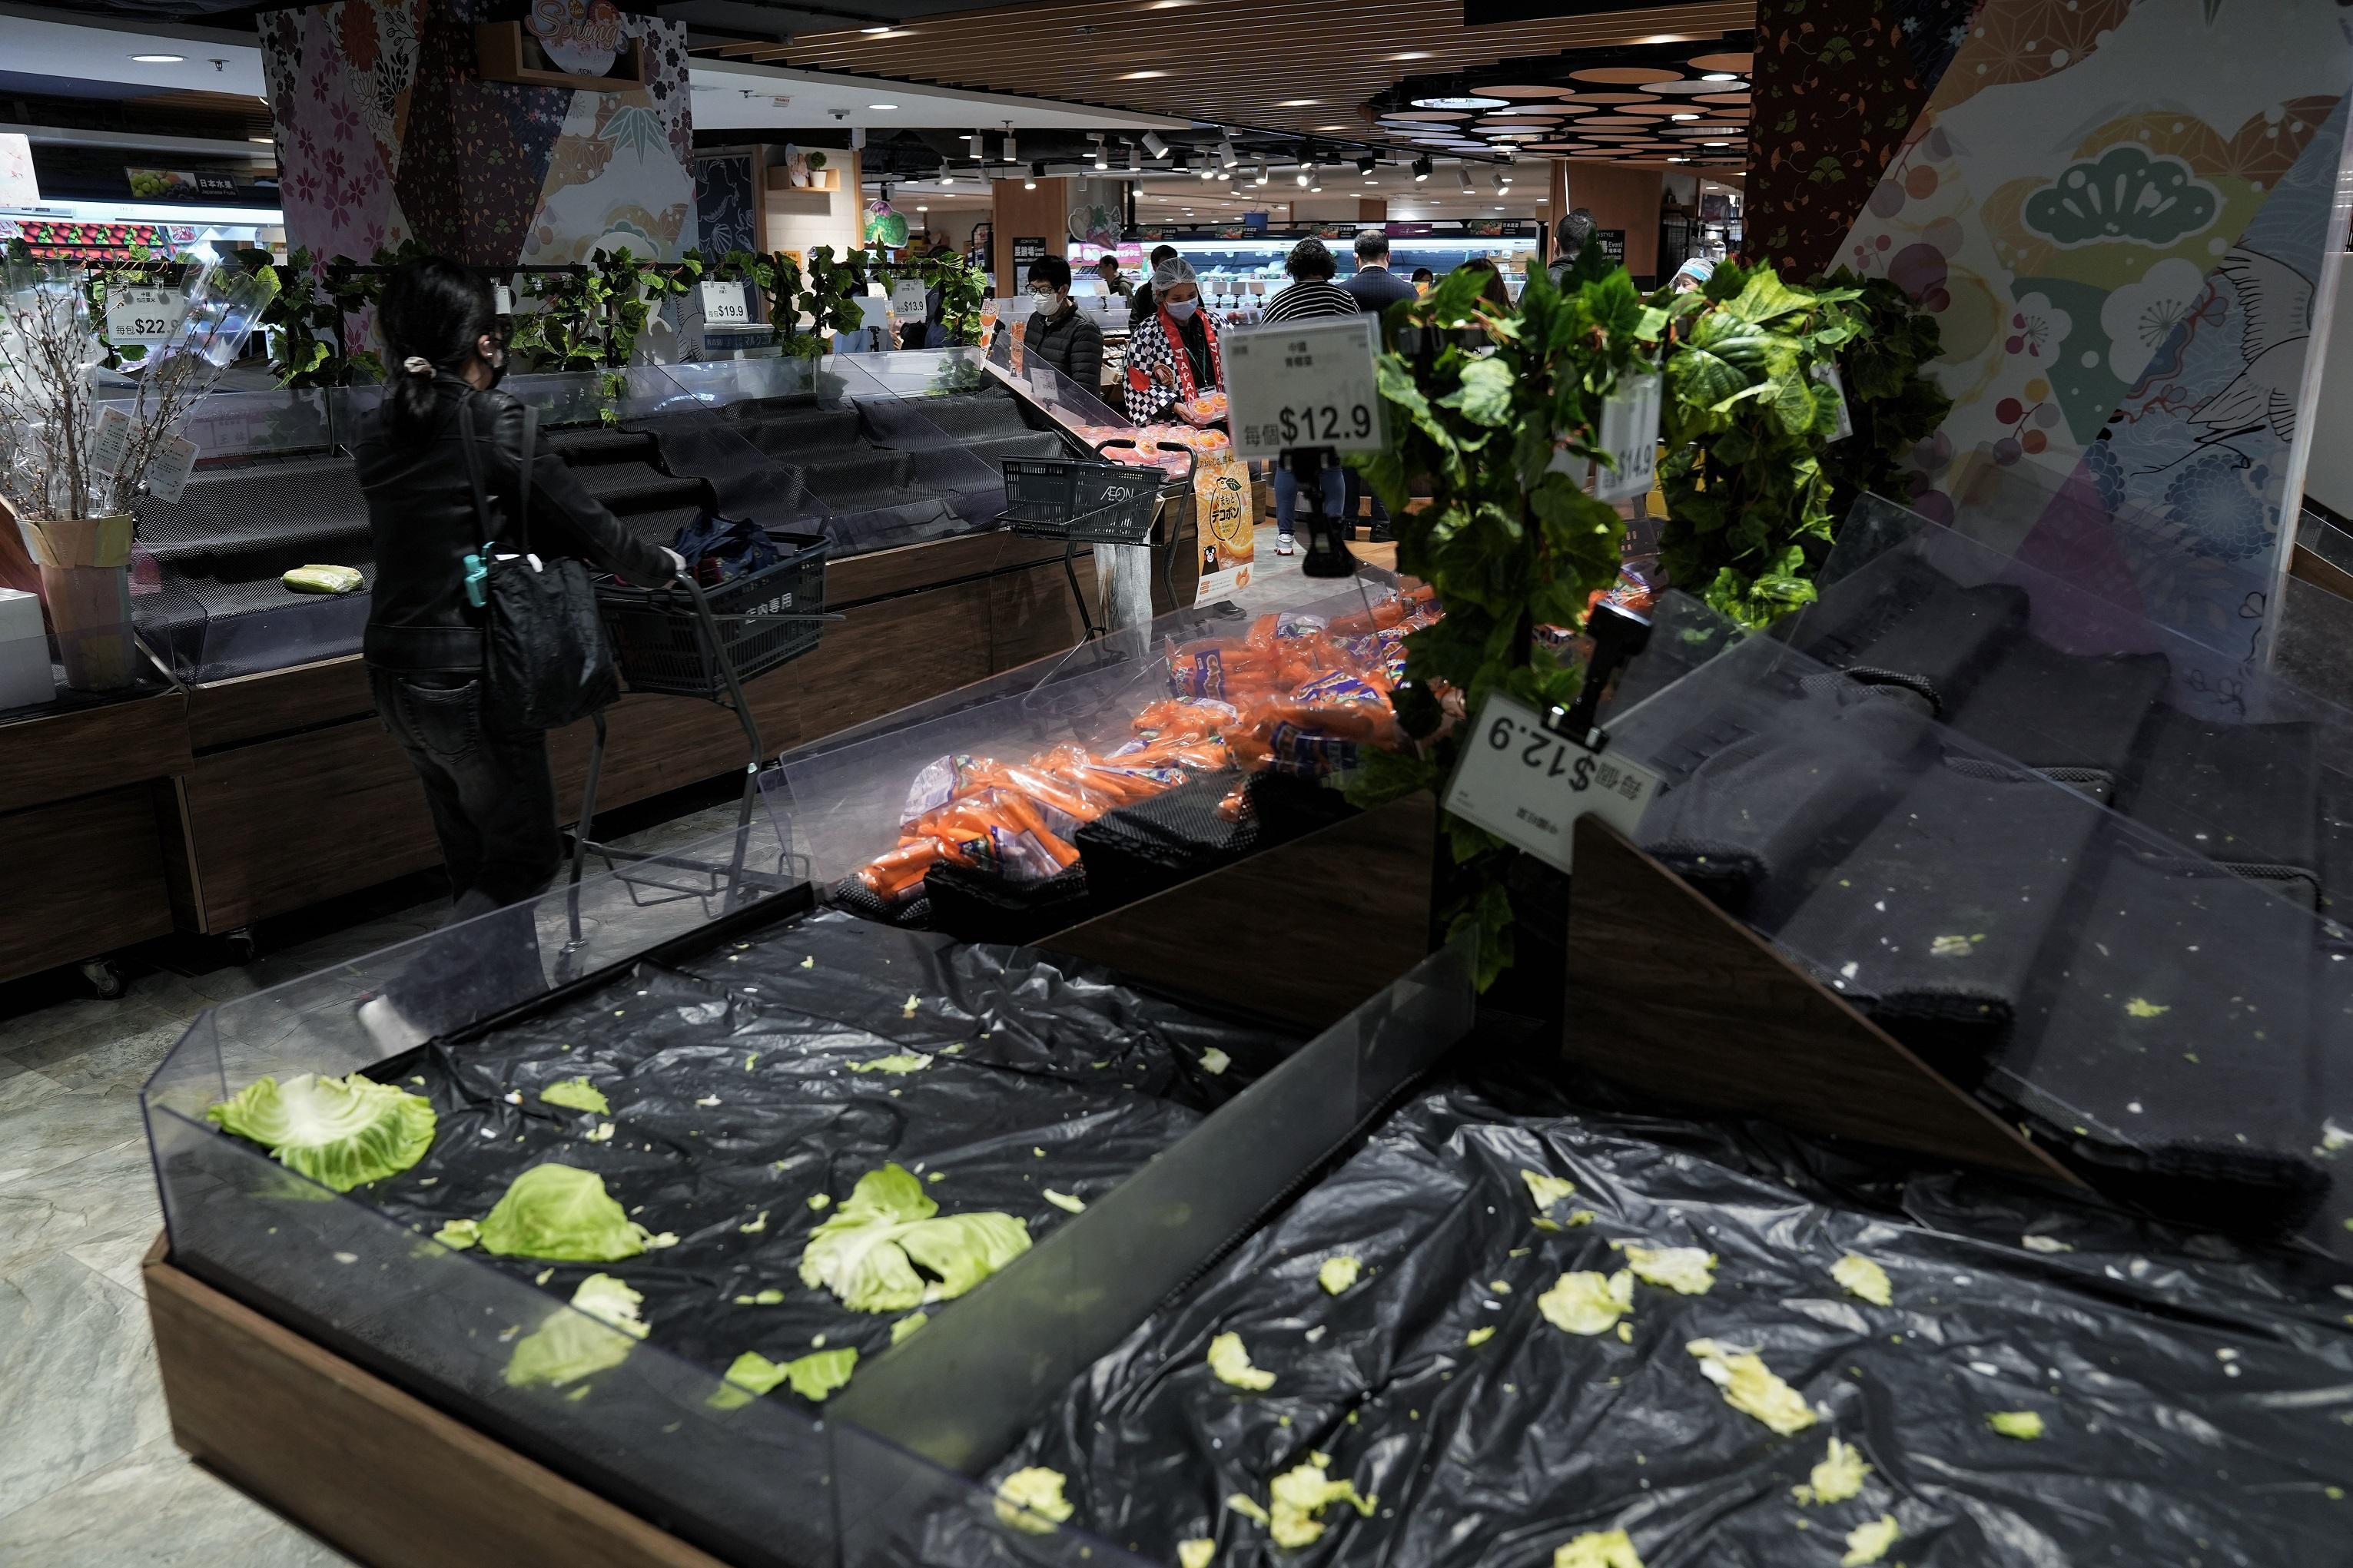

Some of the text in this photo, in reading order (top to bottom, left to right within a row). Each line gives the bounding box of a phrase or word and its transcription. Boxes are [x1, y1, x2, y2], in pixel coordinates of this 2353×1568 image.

[524, 1, 618, 51] Spring
[200, 179, 234, 189] 日本水果
[718, 305, 744, 318] $19.9
[904, 300, 924, 312] $13.9
[116, 325, 134, 336] 每包
[1174, 347, 1196, 402] JAPAN
[1244, 402, 1372, 447] 每個 $12.9
[1216, 493, 1236, 507] くまもと
[1211, 506, 1240, 524] デコポン
[1488, 717, 1643, 801] 每個 $12.9
